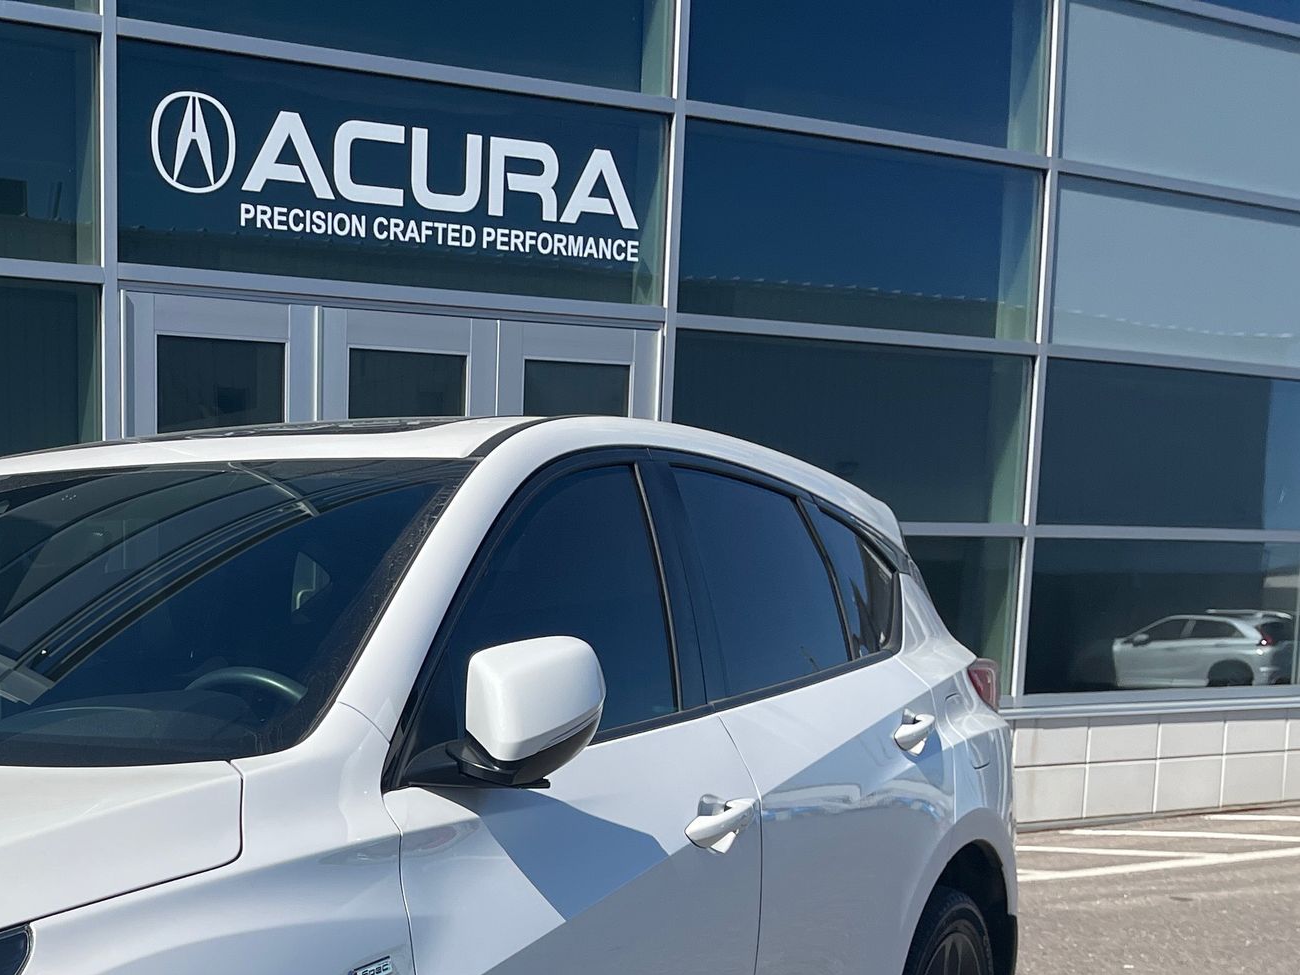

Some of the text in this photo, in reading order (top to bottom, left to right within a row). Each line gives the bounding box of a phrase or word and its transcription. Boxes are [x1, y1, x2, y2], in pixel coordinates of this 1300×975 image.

[240, 109, 640, 230] ACURA
[239, 203, 640, 263] PRECISION CRAFTED PERFORMANCE
